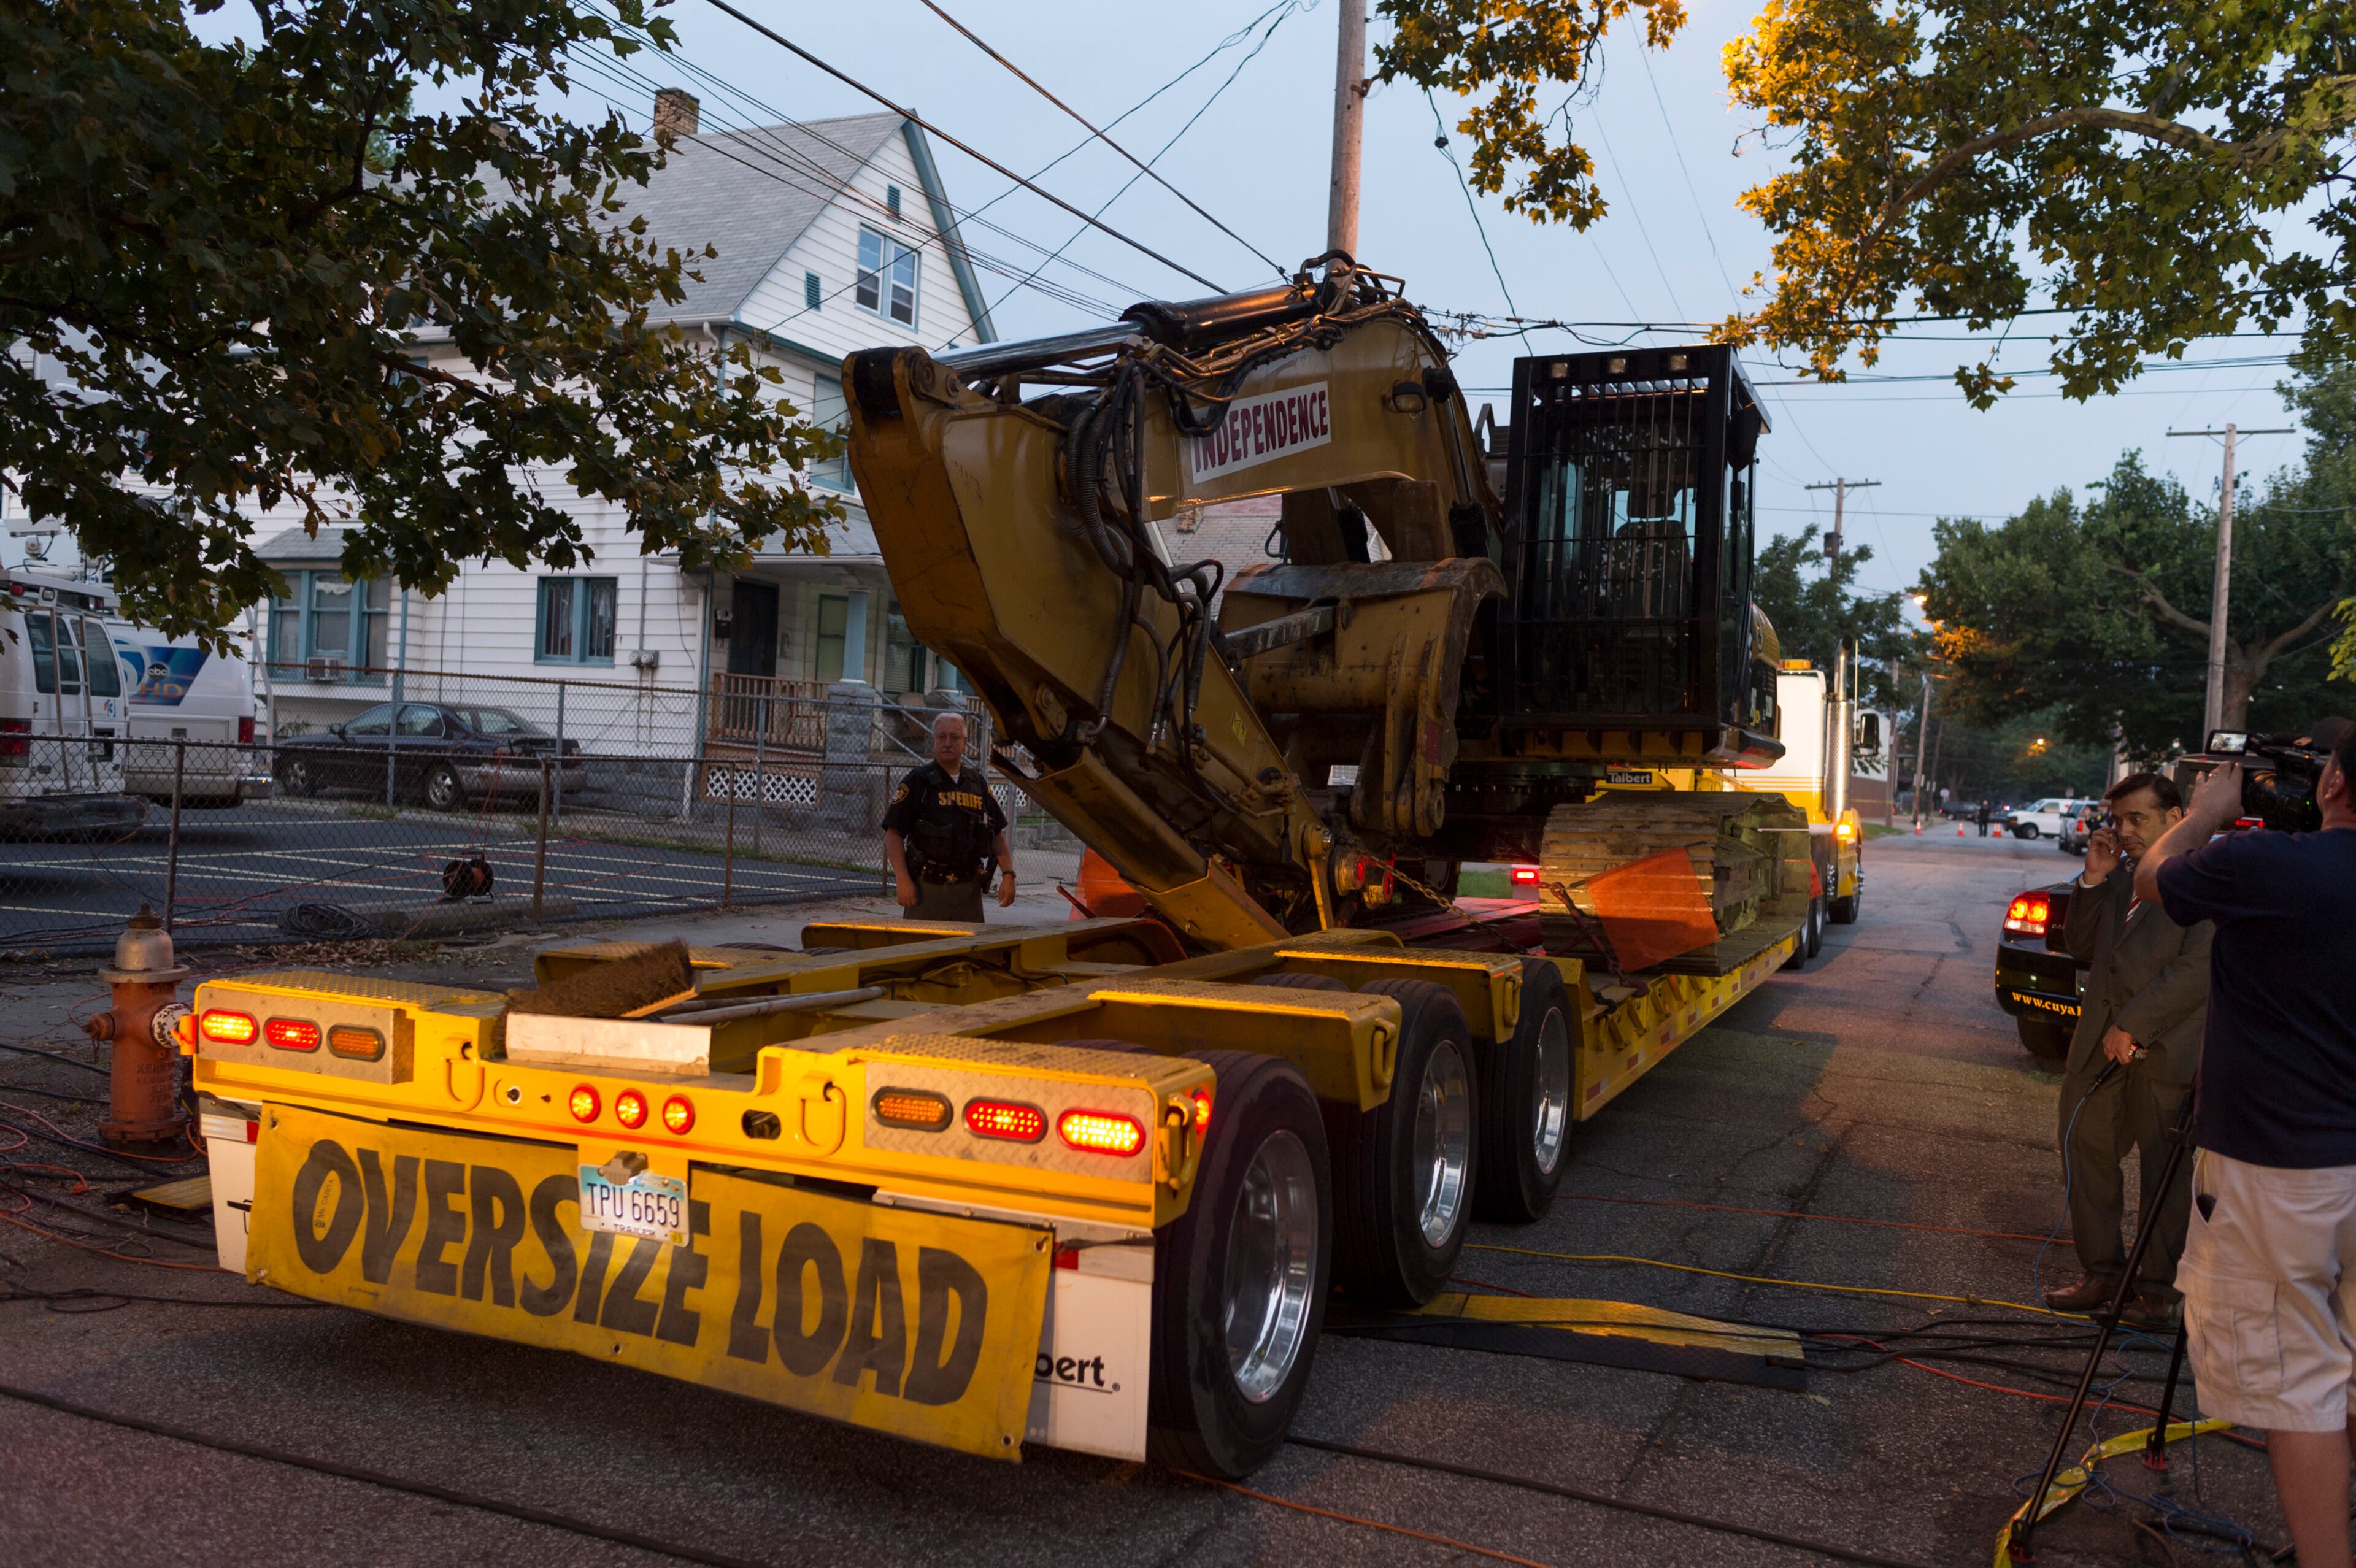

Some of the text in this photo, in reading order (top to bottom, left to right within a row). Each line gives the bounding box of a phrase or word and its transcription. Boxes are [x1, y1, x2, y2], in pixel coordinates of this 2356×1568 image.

[1193, 390, 1328, 473] INDEPENDENCE
[148, 666, 167, 676] abc
[140, 682, 184, 699] HD
[1607, 772, 1650, 783] Talbert
[937, 790, 983, 810] SHERIFF
[586, 1182, 679, 1228] TPU 6659
[614, 1223, 656, 1237] TRAILER
[293, 1139, 988, 1407] OVERSIZE LOAD
[1034, 1353, 1105, 1388] bert
